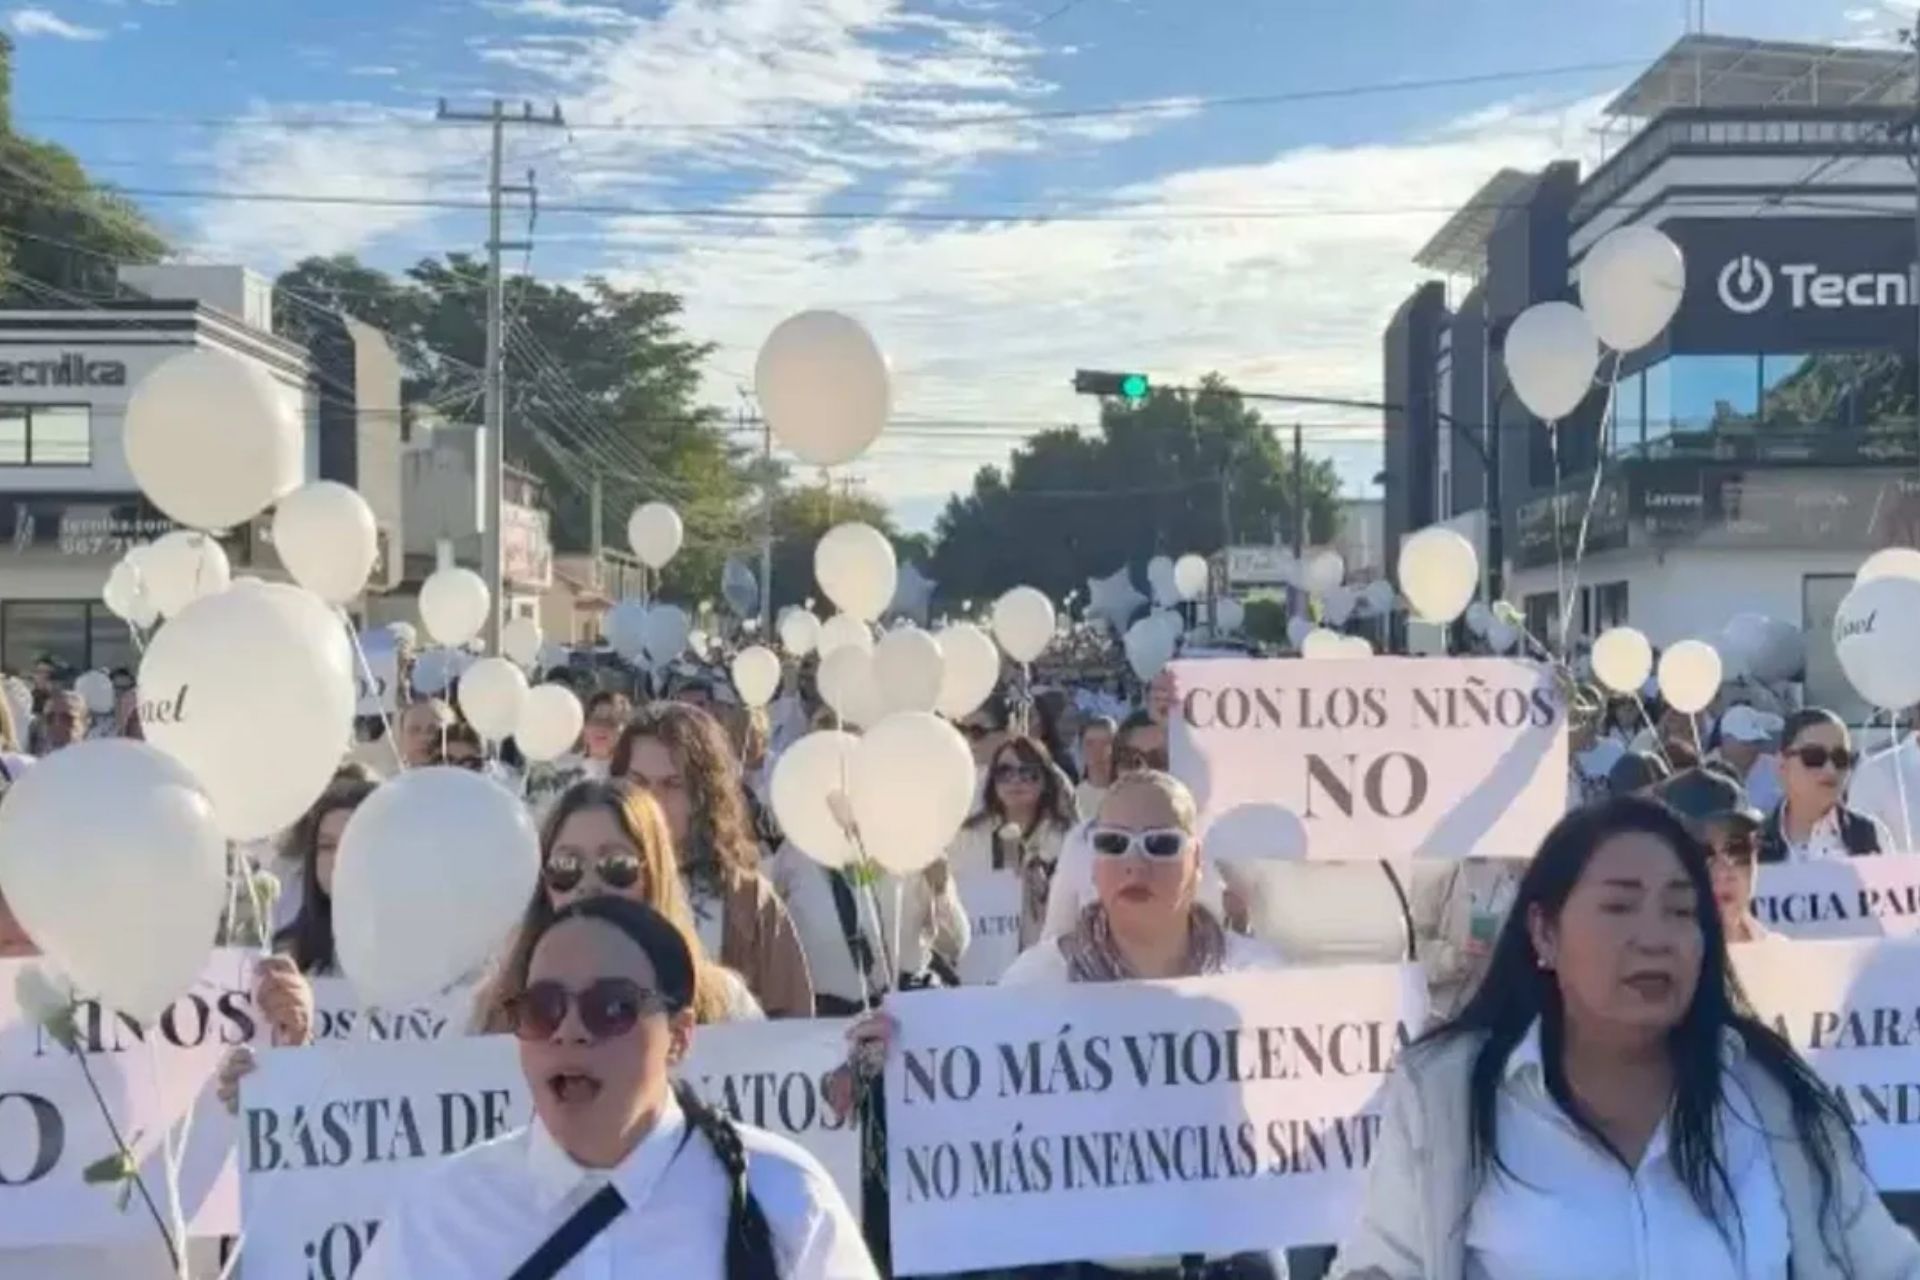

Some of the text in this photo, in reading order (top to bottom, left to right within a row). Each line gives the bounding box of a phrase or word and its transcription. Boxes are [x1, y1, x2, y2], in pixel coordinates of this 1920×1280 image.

[1183, 675, 1555, 729] CON LOS NIÑOS
[1304, 751, 1429, 819] NO
[902, 1044, 981, 1104] NO
[998, 1024, 1112, 1095] MÁS
[246, 1096, 425, 1173] BASTA
[906, 1144, 960, 1202] NO
[971, 1122, 1052, 1196] MÁS
[1062, 1122, 1257, 1190] INFANCIAS
[1267, 1116, 1327, 1176] SIN
